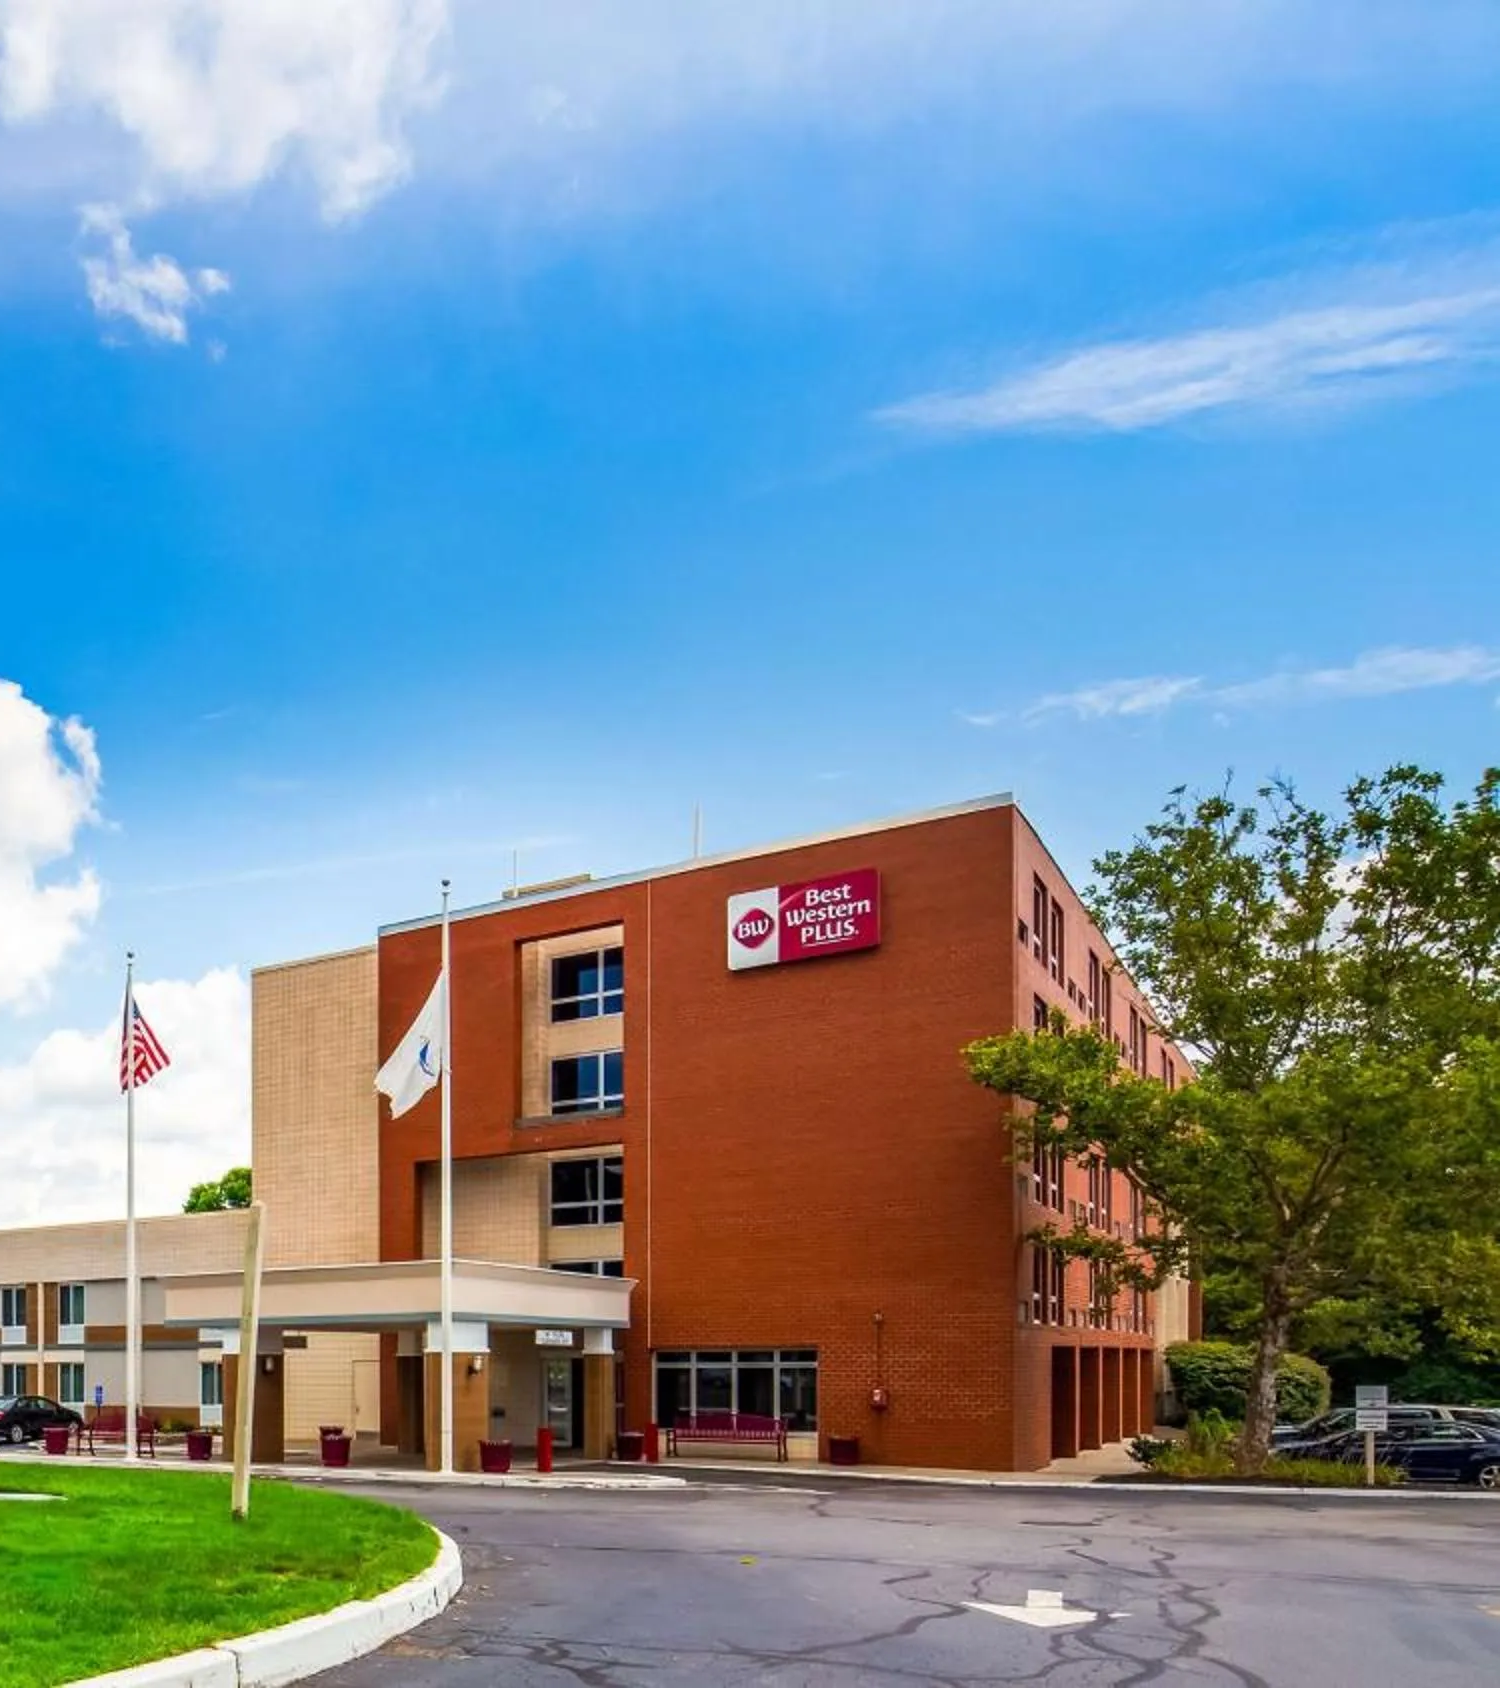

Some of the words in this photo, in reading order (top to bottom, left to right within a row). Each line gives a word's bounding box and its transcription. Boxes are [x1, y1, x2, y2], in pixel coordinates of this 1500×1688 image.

[805, 883, 852, 907] Best
[785, 899, 871, 927] Western
[737, 919, 770, 940] BW
